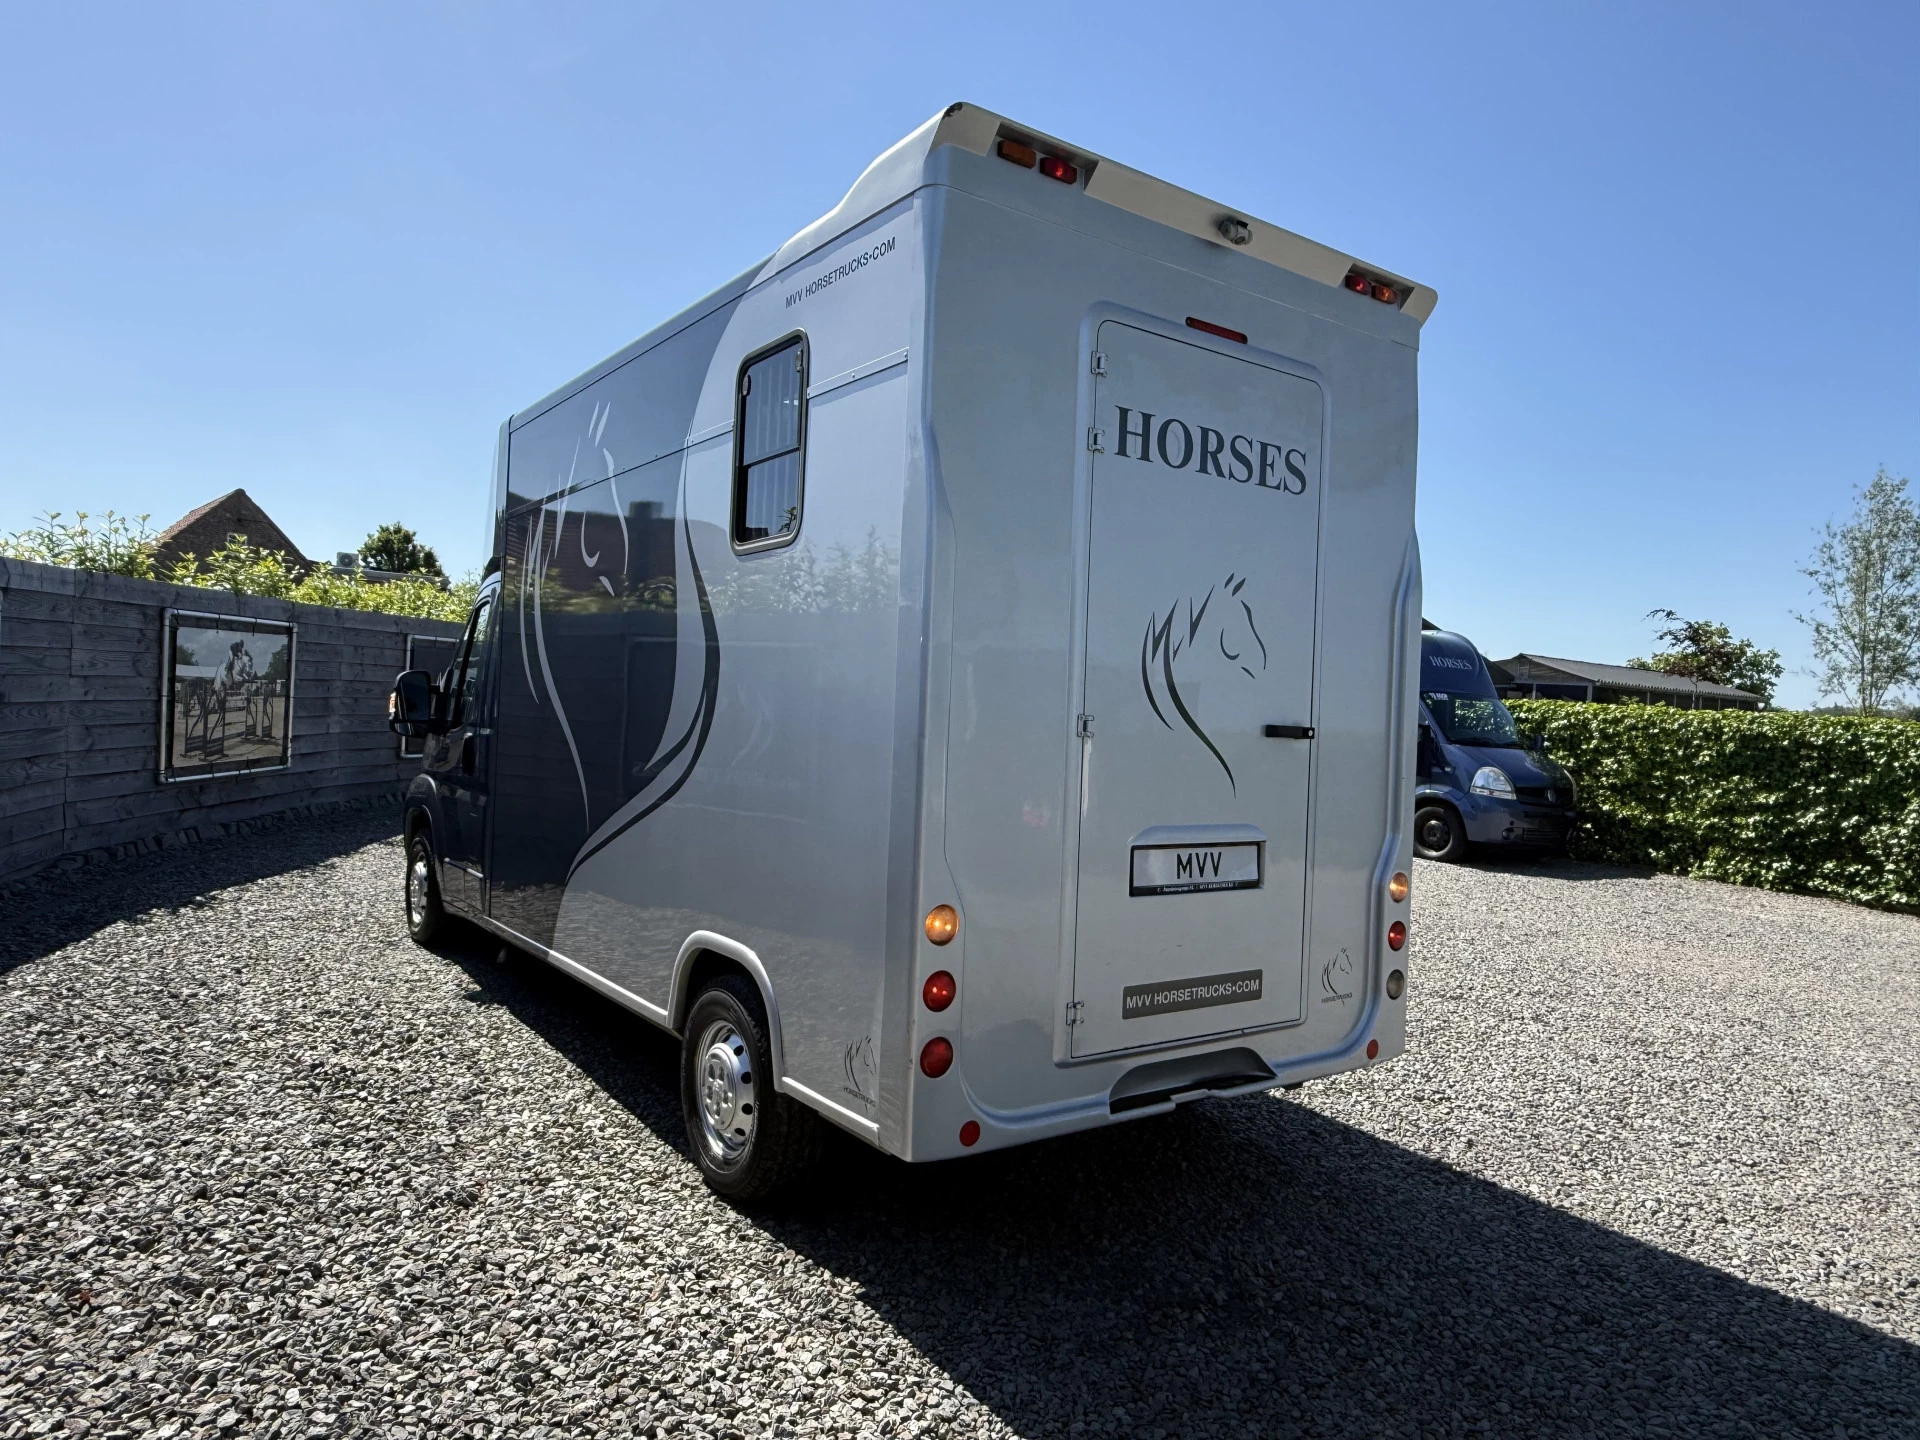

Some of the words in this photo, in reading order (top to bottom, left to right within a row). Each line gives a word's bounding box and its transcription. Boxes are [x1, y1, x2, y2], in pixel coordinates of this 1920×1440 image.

[785, 289, 803, 309] MVV
[1113, 404, 1307, 496] HORSES
[1429, 655, 1472, 670] HORSES
[1176, 851, 1222, 879] MVV
[1126, 993, 1152, 1009] MVV
